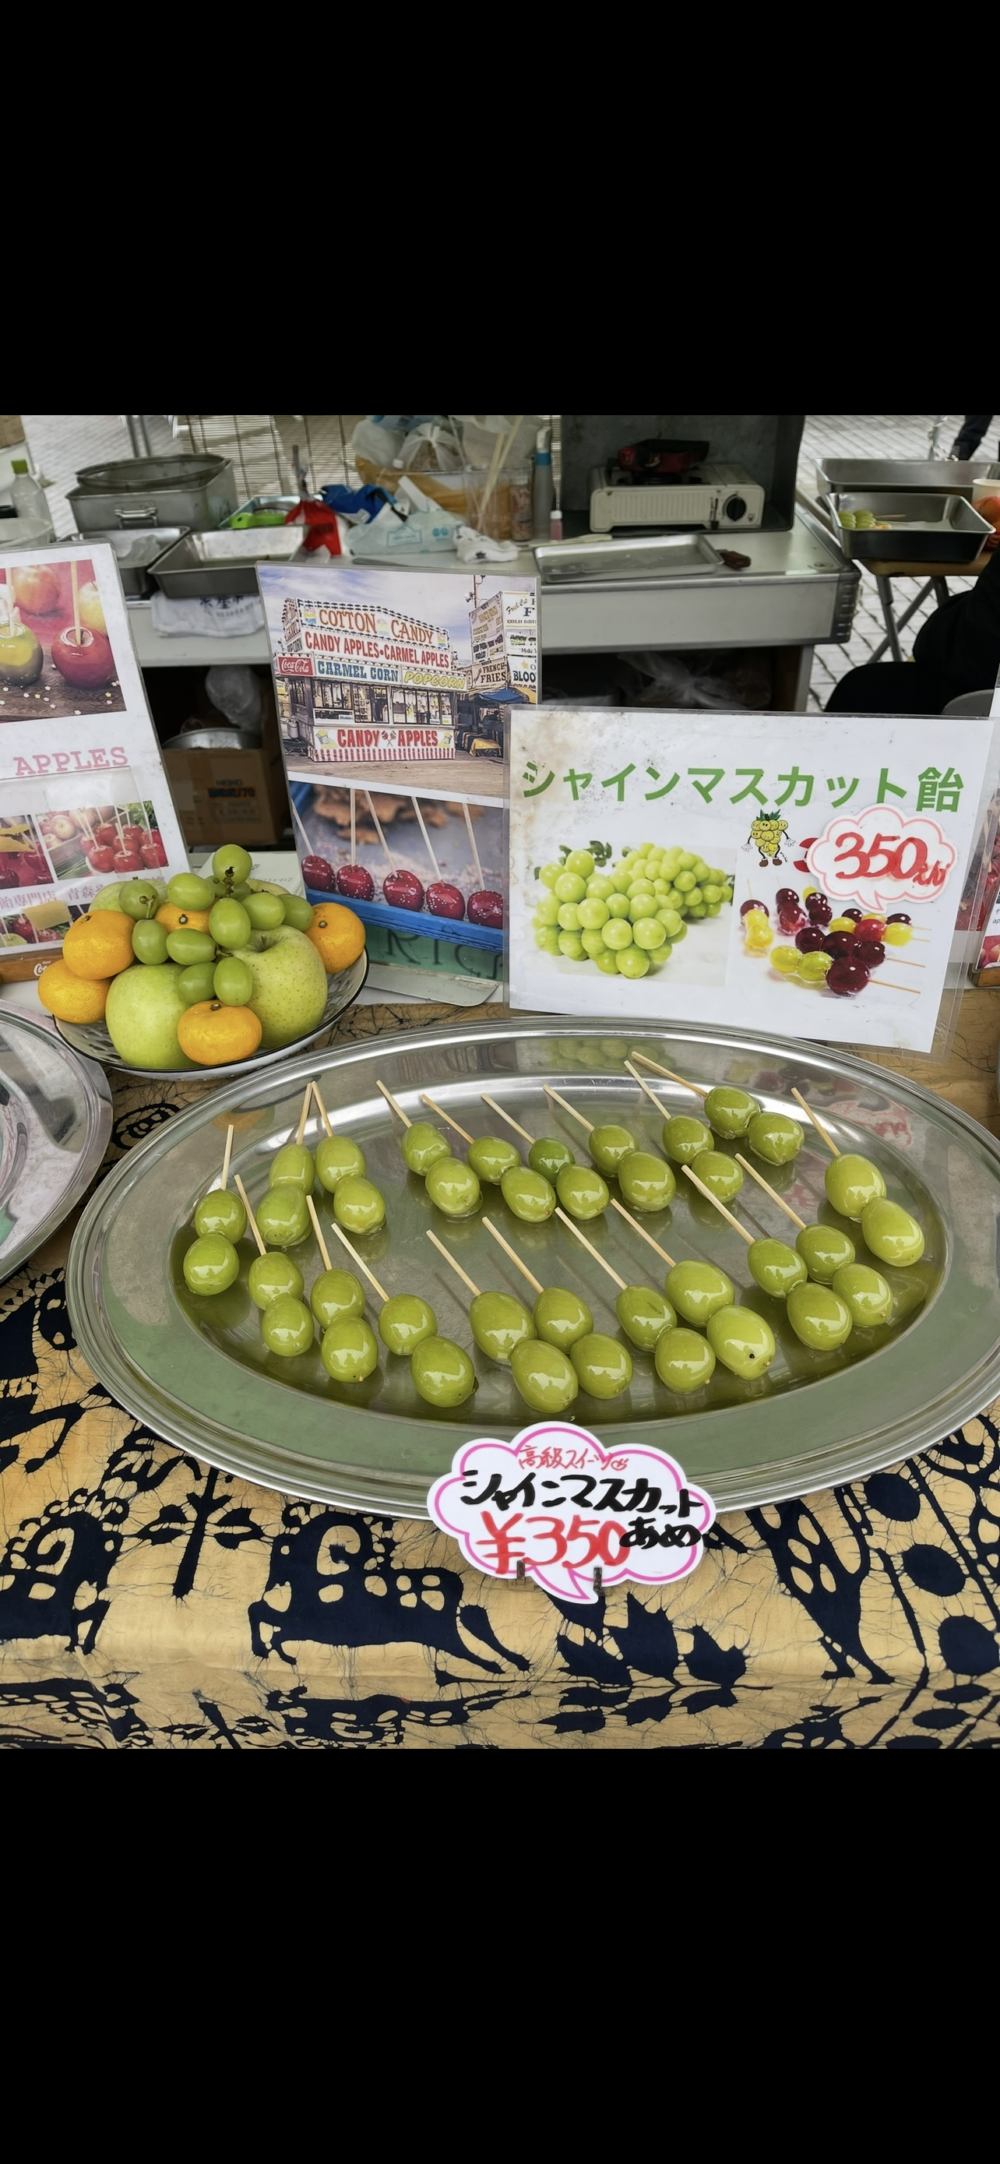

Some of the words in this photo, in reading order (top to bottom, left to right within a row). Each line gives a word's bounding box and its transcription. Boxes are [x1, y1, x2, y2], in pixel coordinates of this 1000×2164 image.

[319, 609, 377, 635] COTTON
[390, 619, 433, 645] CANDY
[305, 631, 341, 653] CANDY
[343, 638, 380, 659] APPLES
[384, 644, 420, 665] CARMEL
[421, 651, 449, 669] APPLES
[317, 660, 367, 680] CARMEL
[370, 669, 399, 683] CORN
[403, 672, 466, 690] POPCORN
[480, 671, 507, 684] FRIES
[337, 729, 380, 748] CANDY
[397, 730, 439, 747] APPLES
[13, 747, 128, 776] APPLES
[522, 761, 966, 813] シャインマスカット飴
[460, 1470, 704, 1517] シャインマスカット
[475, 1511, 631, 1574] ¥350
[619, 1517, 701, 1549] あめ
